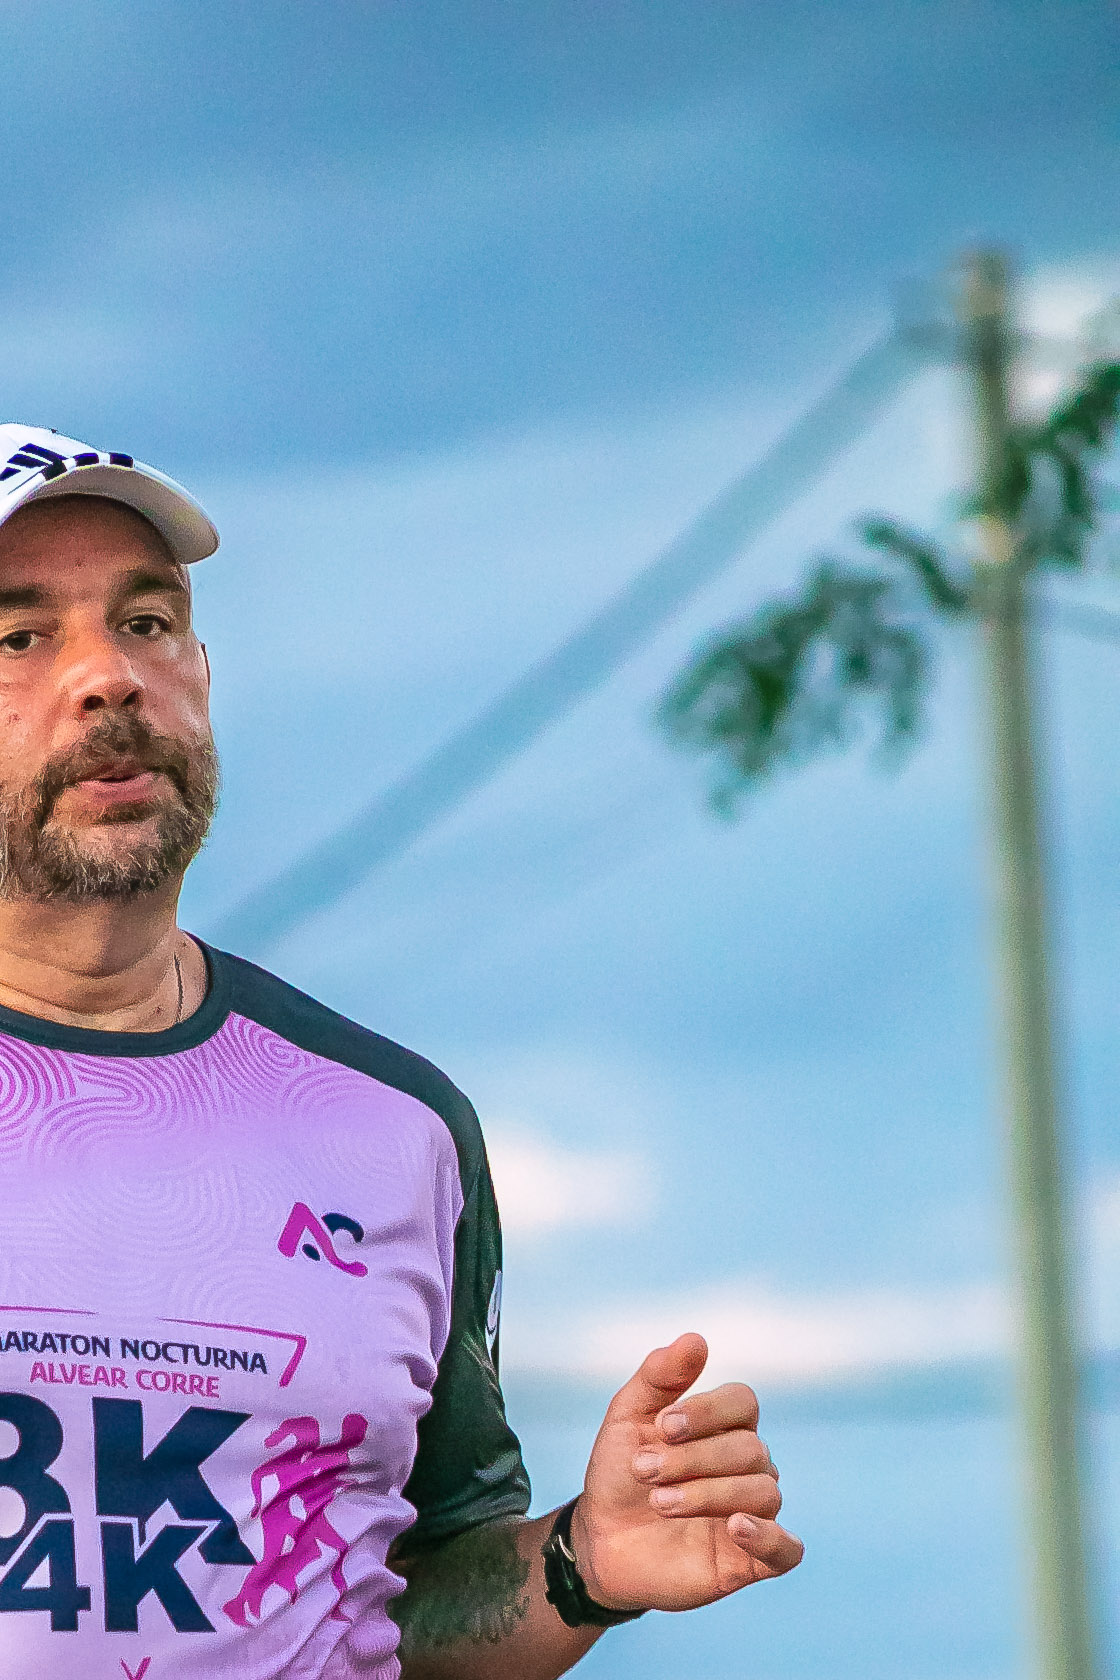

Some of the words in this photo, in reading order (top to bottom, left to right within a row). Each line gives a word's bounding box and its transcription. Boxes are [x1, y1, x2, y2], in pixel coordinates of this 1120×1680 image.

[120, 1337, 268, 1375] NOCTURNA
[29, 1360, 129, 1389] ALVEAR
[135, 1368, 221, 1399] CORRE
